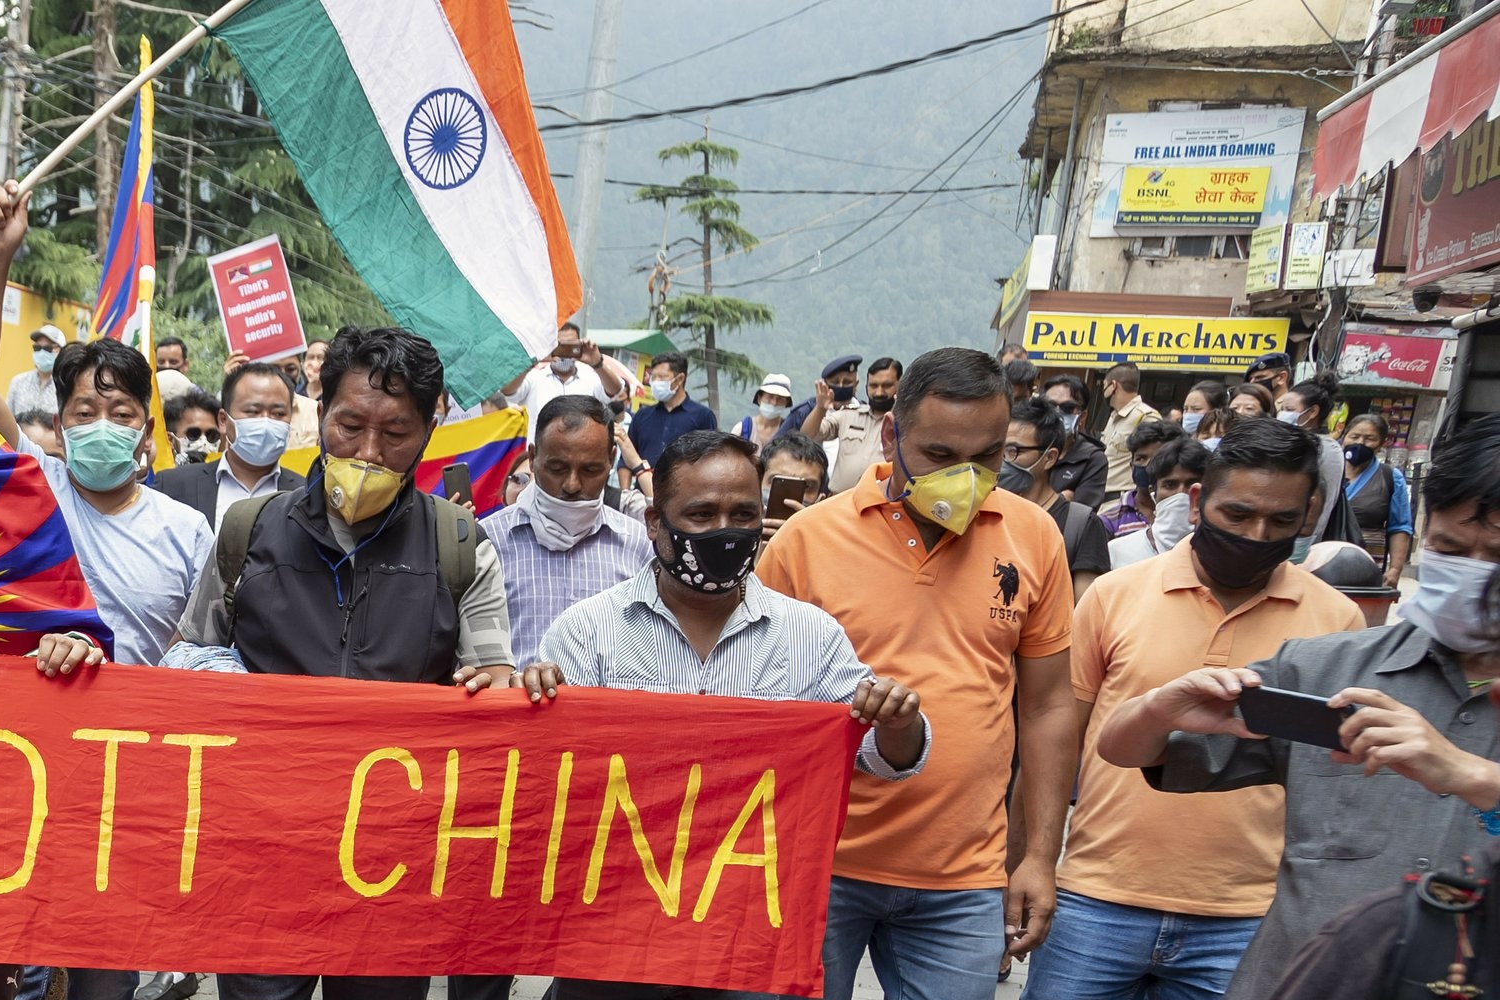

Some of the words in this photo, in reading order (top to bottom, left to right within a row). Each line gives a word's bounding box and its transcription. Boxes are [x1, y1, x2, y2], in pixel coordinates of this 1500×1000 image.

[1134, 146, 1161, 159] FREE
[1162, 146, 1181, 158] ALL
[1185, 144, 1217, 158] INDIA
[1220, 142, 1275, 157] ROAMING
[1210, 171, 1250, 186] ग्राहक
[1136, 188, 1170, 198] BSNL
[1195, 187, 1225, 204] सेवा
[1230, 187, 1258, 204] केन्द्र
[1470, 231, 1494, 253] Espresso
[238, 279, 269, 297] Tibet's
[228, 290, 287, 317] Independence
[244, 309, 276, 328] India's
[245, 323, 283, 343] security
[1031, 321, 1097, 347] Paul
[1111, 322, 1278, 351] Merchants
[1043, 352, 1068, 360] FOREIGN
[1068, 353, 1098, 361] EXCHANGE
[1127, 354, 1148, 362] MONEY
[1149, 355, 1179, 363] TRANSFER
[990, 607, 1017, 622] USPA
[339, 747, 782, 928] CHINA
